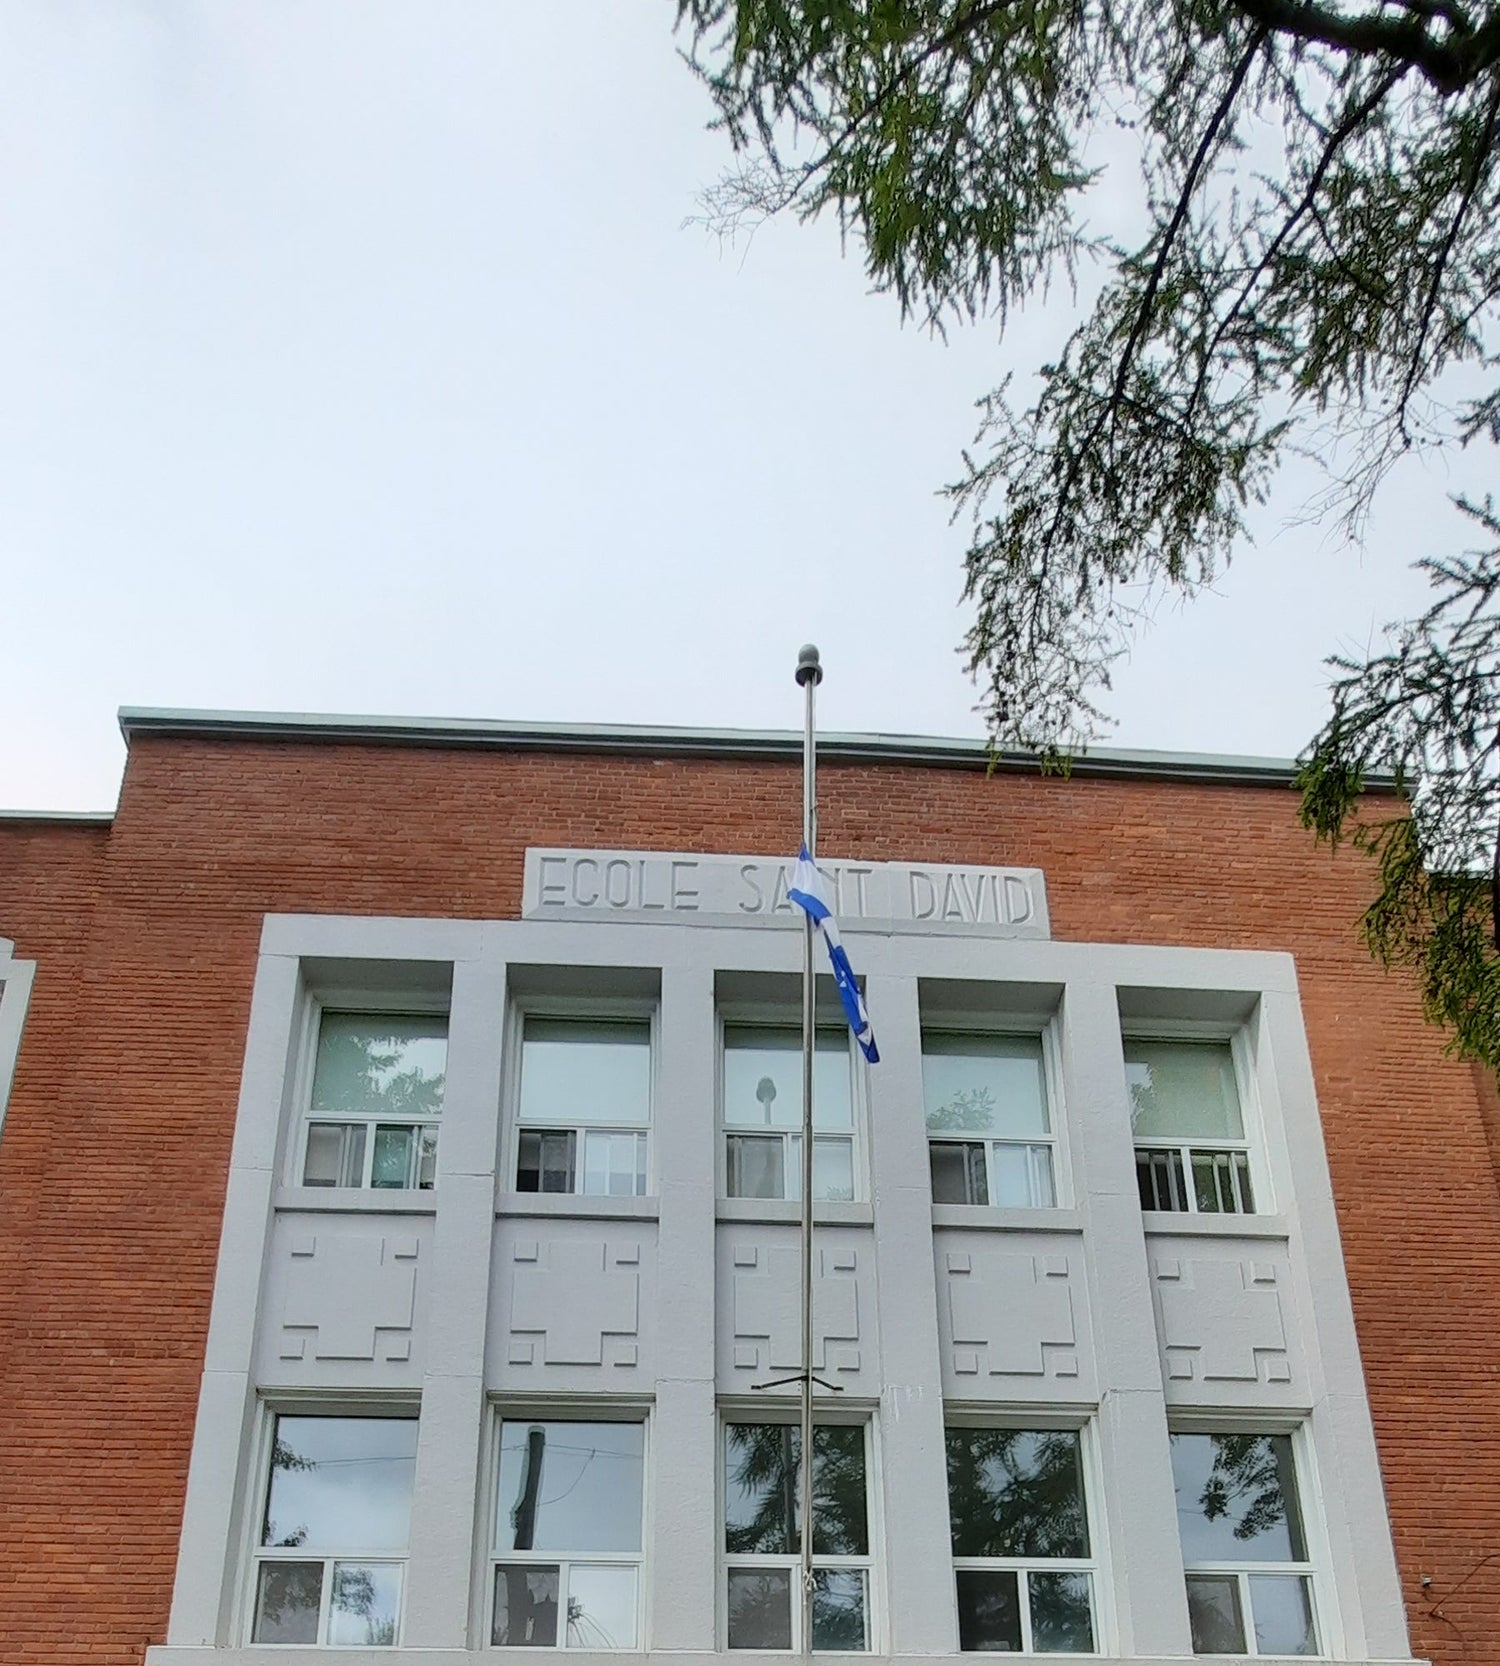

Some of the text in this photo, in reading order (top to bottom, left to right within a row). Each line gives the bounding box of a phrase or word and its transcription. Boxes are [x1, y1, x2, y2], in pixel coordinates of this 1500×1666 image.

[540, 857, 1034, 924] ECOLE SANT DAVID
